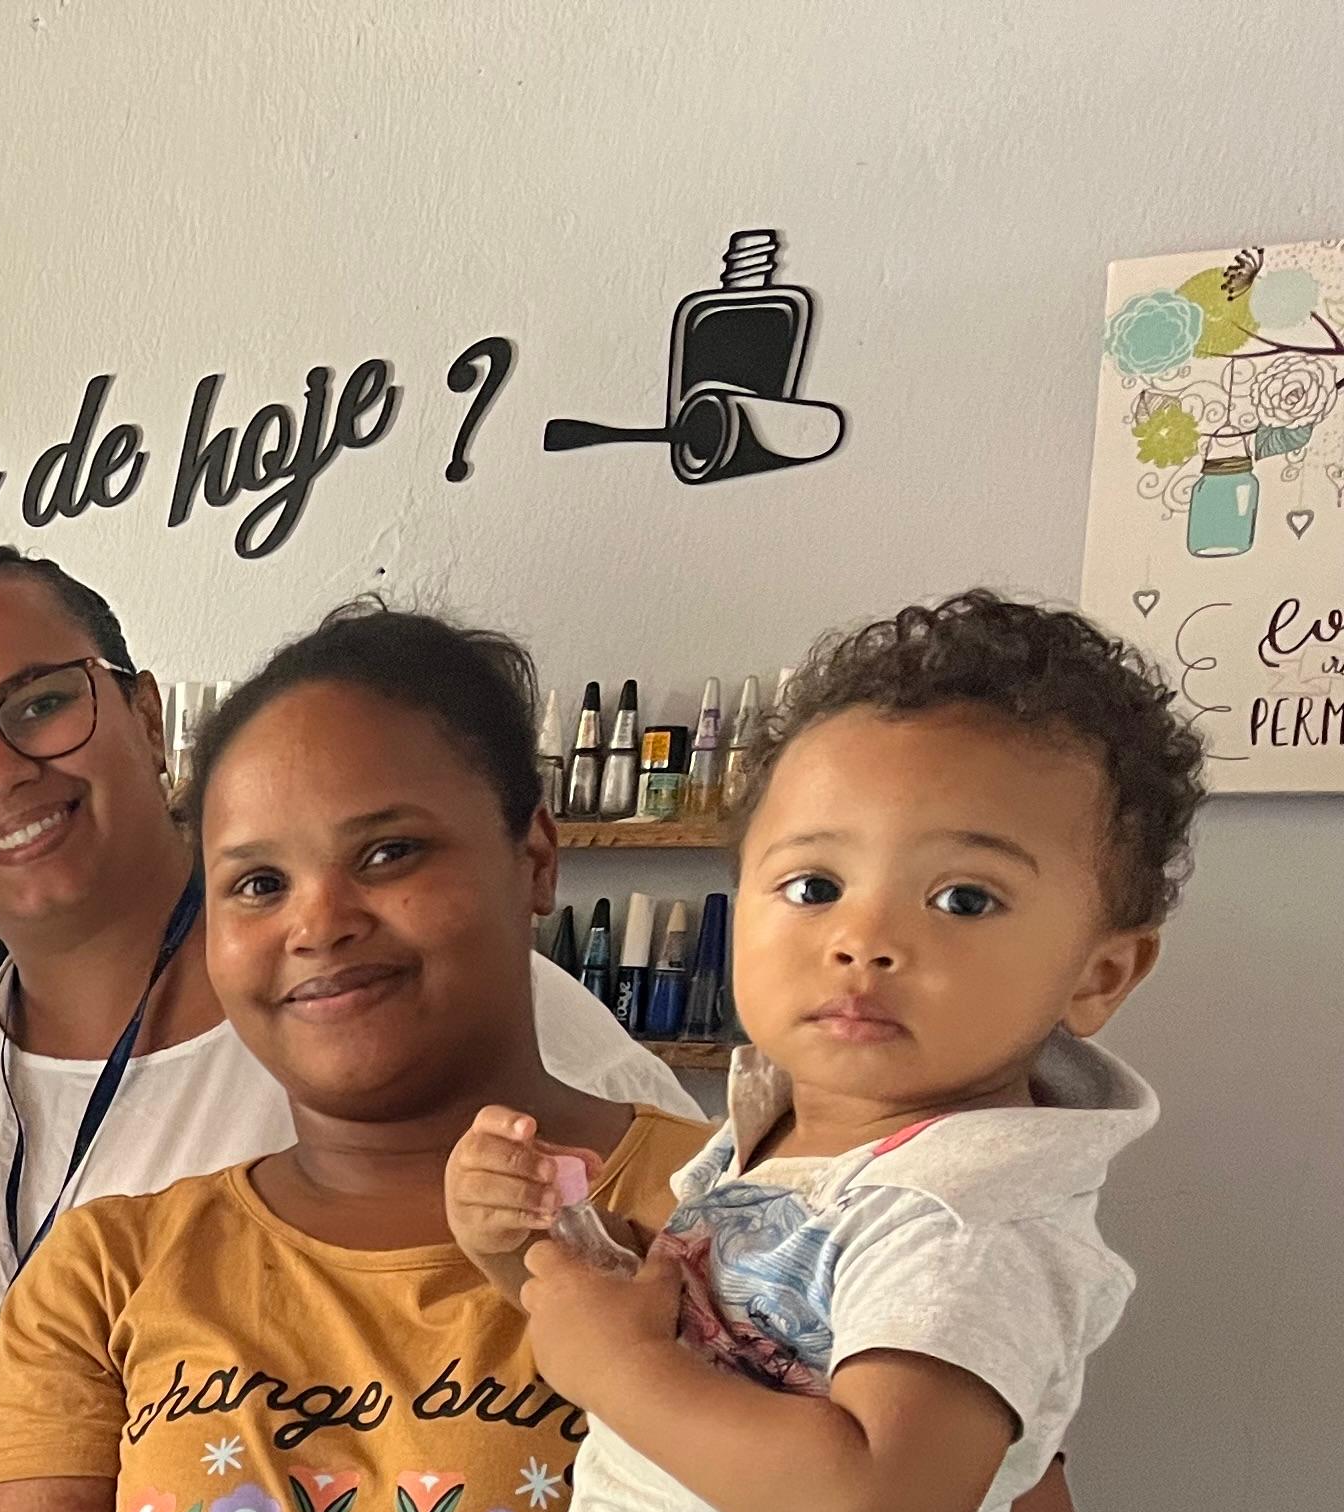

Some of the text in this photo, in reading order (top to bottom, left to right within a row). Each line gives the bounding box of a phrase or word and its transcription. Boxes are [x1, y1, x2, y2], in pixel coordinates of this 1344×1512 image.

[22, 373, 147, 527] de
[168, 359, 400, 559] hoje
[128, 1357, 591, 1487] change brin
